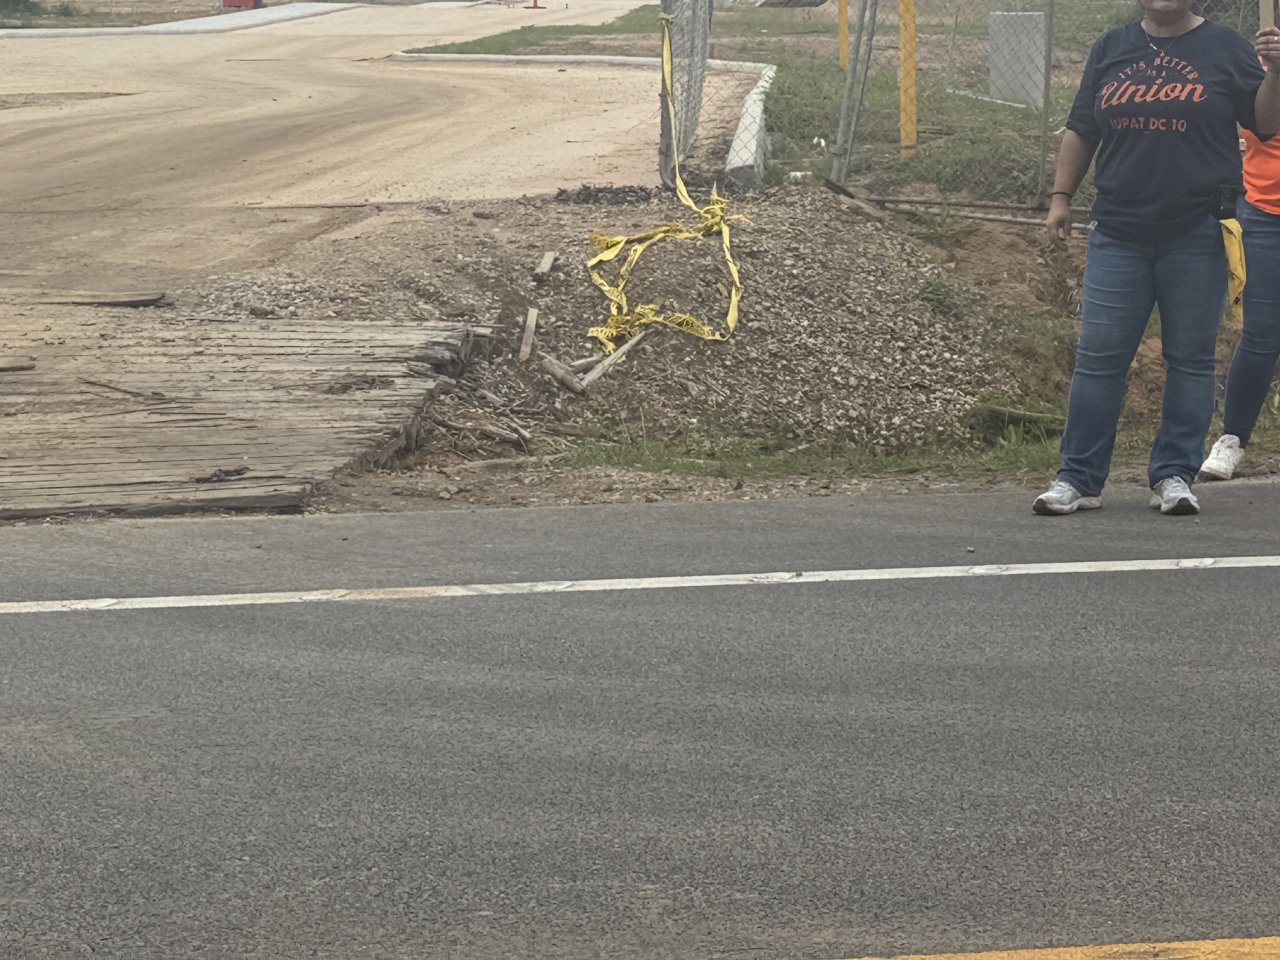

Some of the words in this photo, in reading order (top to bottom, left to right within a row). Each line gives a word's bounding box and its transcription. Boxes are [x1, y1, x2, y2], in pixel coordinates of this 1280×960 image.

[1154, 55, 1199, 80] BETTER
[1101, 78, 1208, 110] Union
[1109, 117, 1145, 130] IUPAT
[1150, 118, 1166, 130] DC
[1172, 118, 1187, 132] 10
